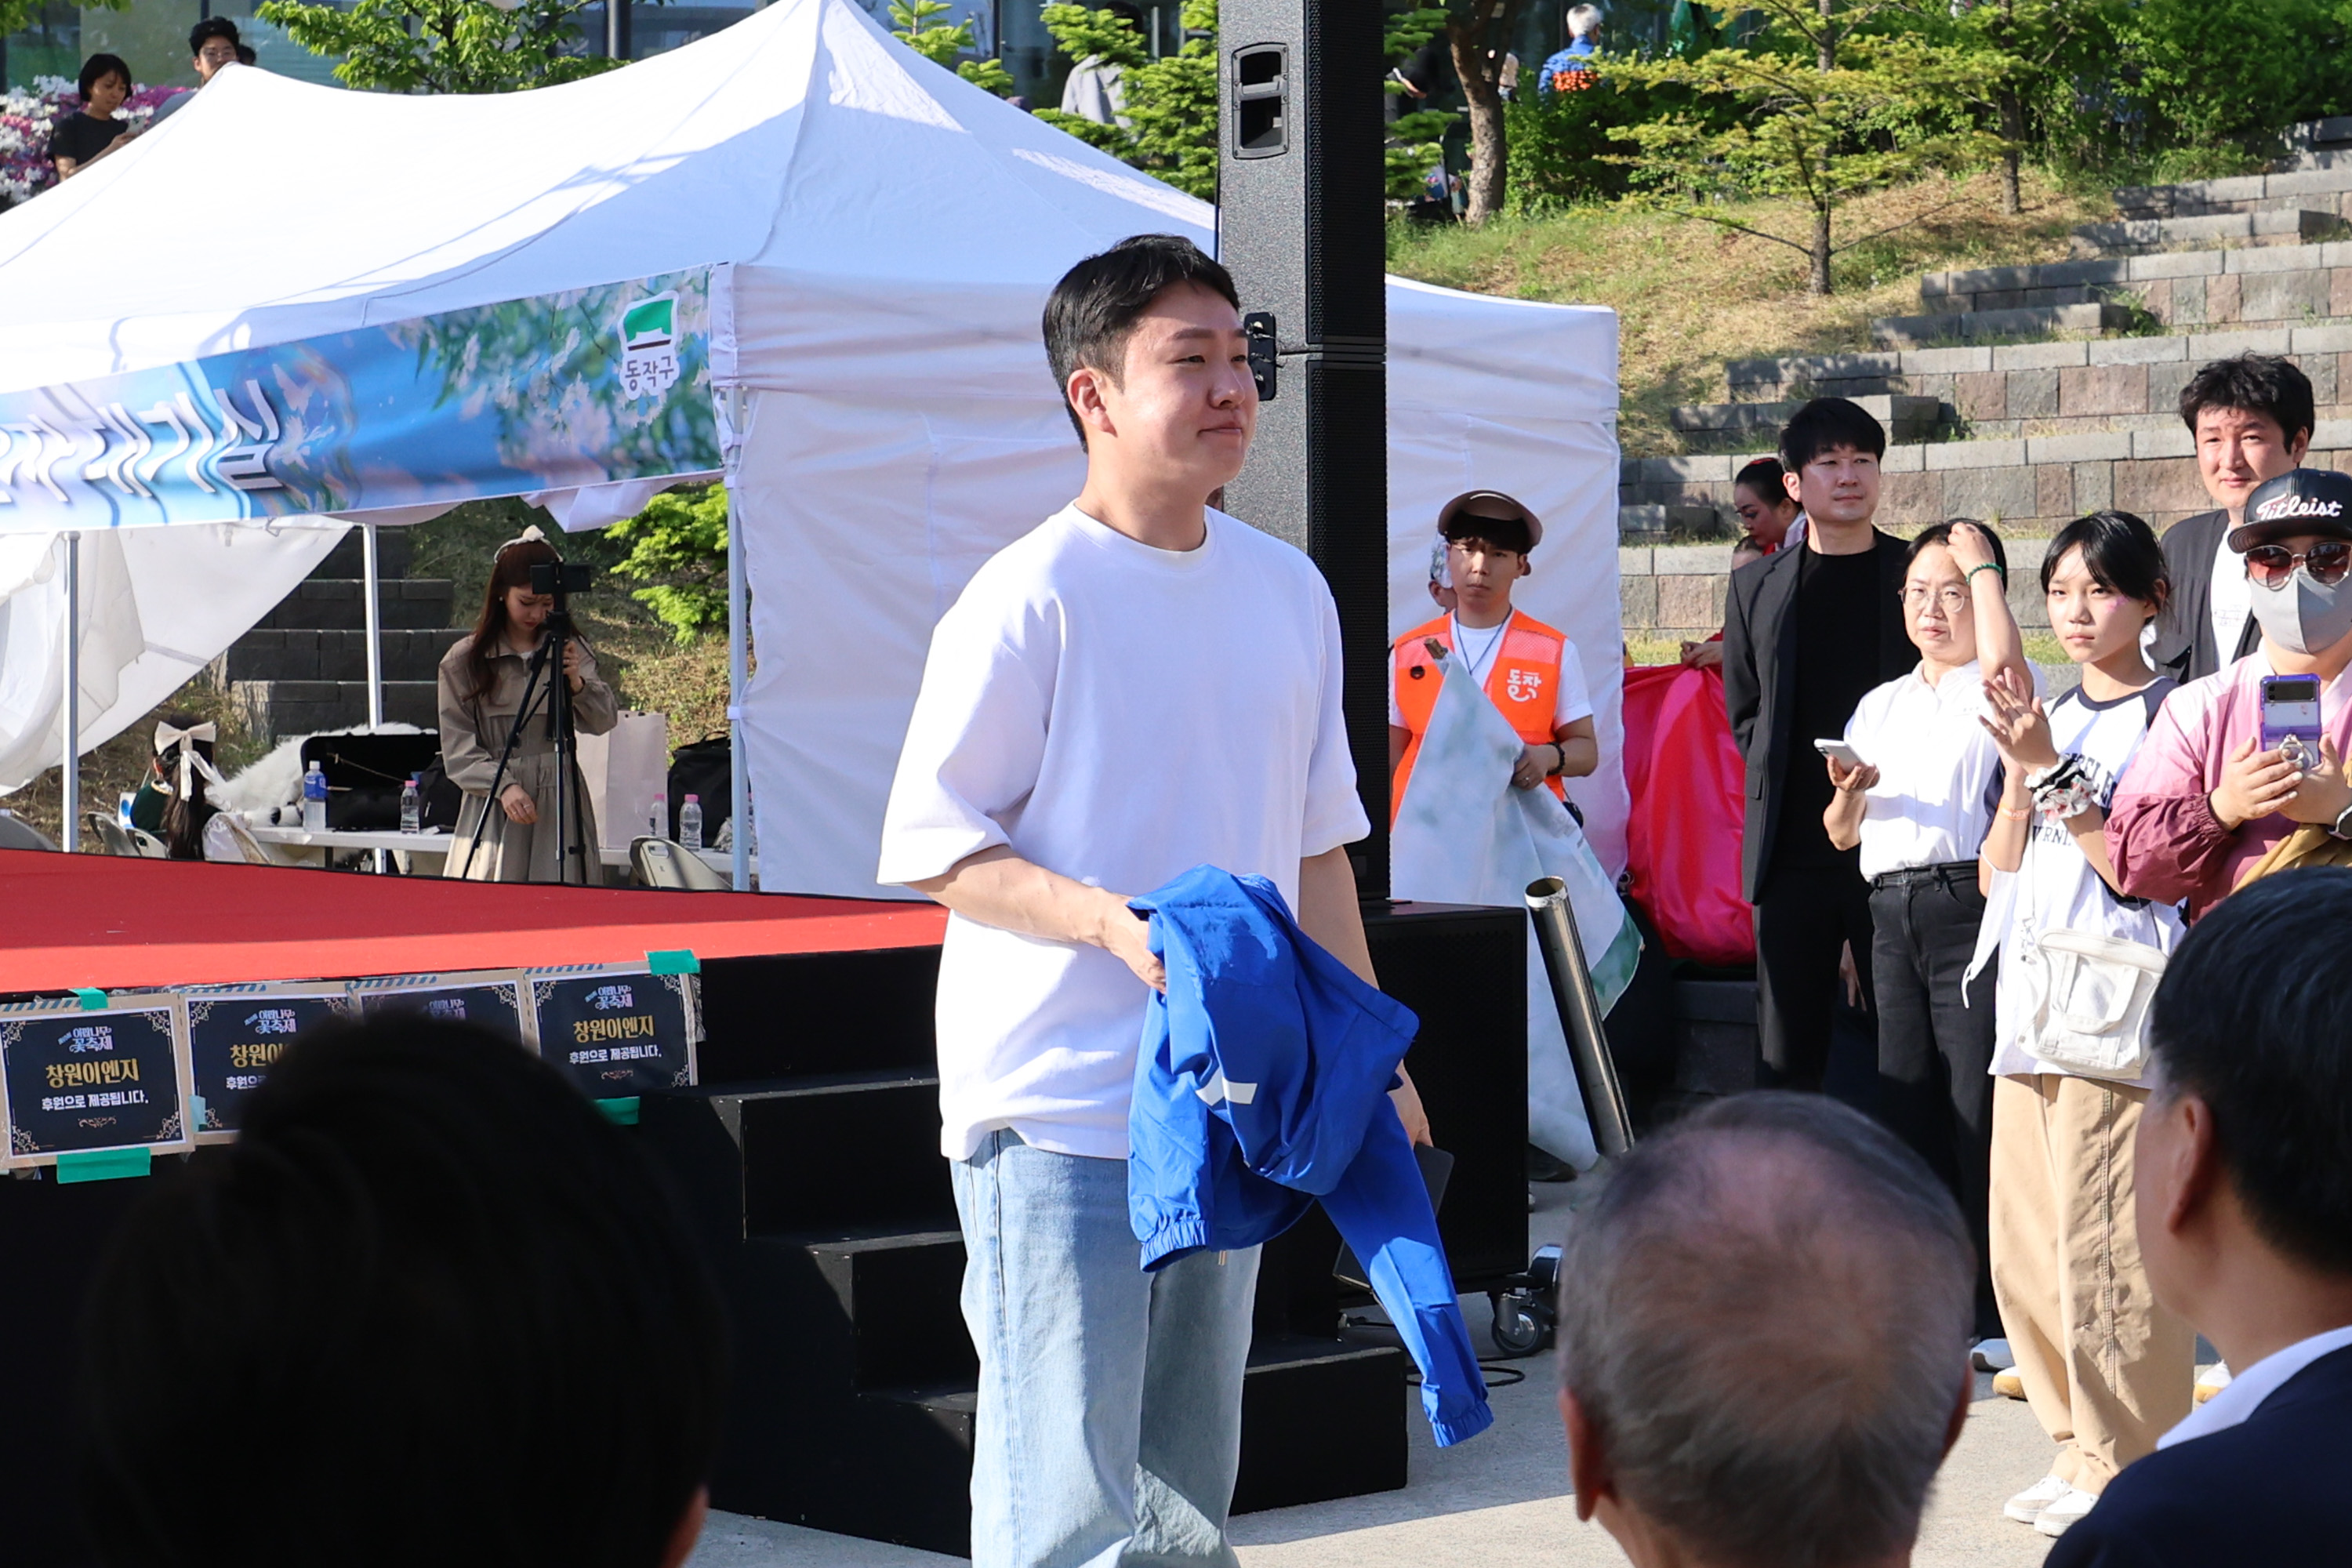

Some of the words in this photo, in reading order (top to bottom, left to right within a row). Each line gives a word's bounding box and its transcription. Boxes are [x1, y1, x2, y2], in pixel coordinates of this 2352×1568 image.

[624, 355, 674, 392] 동작구
[2256, 492, 2343, 521] Titleist
[573, 1014, 655, 1043] 창원이엔지
[230, 1044, 285, 1068] 창원이
[569, 1049, 608, 1065] 후원으로
[610, 1044, 662, 1061] 제공됩니다.
[45, 1058, 140, 1088] 창원이엔지
[42, 1094, 86, 1111] 후원으로
[88, 1090, 149, 1107] 제공됩니다.
